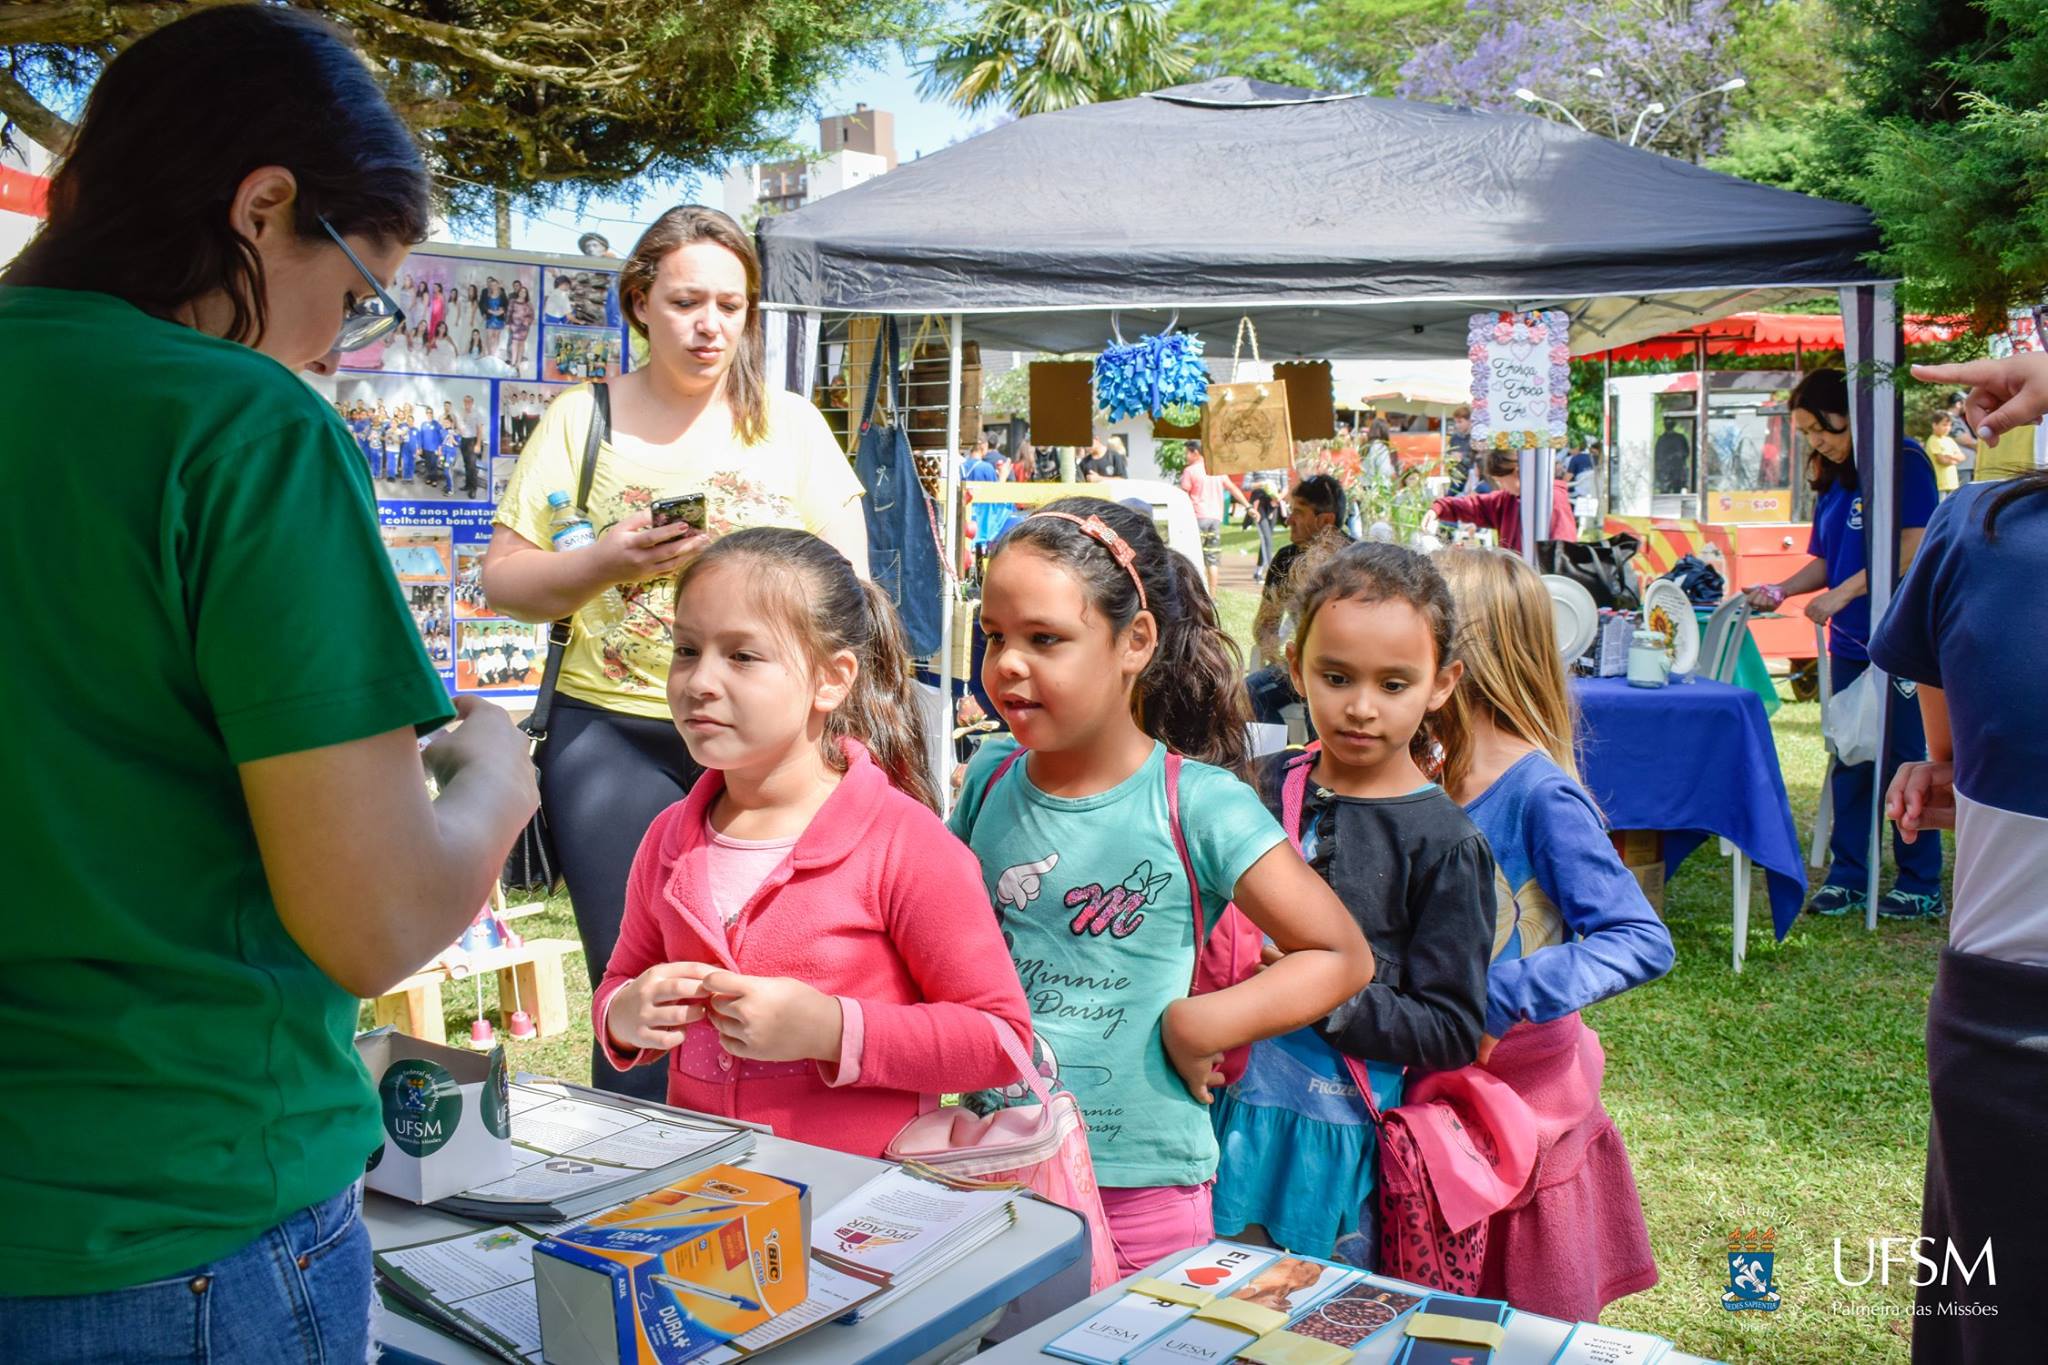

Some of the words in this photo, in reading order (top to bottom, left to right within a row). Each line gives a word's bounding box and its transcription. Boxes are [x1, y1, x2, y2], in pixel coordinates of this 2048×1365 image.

[1503, 379, 1544, 399] Foco
[385, 516, 442, 525] colhendo
[446, 517, 474, 525] bons
[401, 507, 415, 515] 15
[1014, 957, 1132, 998] Minnie
[1033, 989, 1128, 1040] Daisy
[395, 1117, 443, 1138] UFSM
[768, 1246, 780, 1281] BIC
[1088, 1321, 1139, 1341] UFSM
[1165, 1338, 1218, 1359] UFSM
